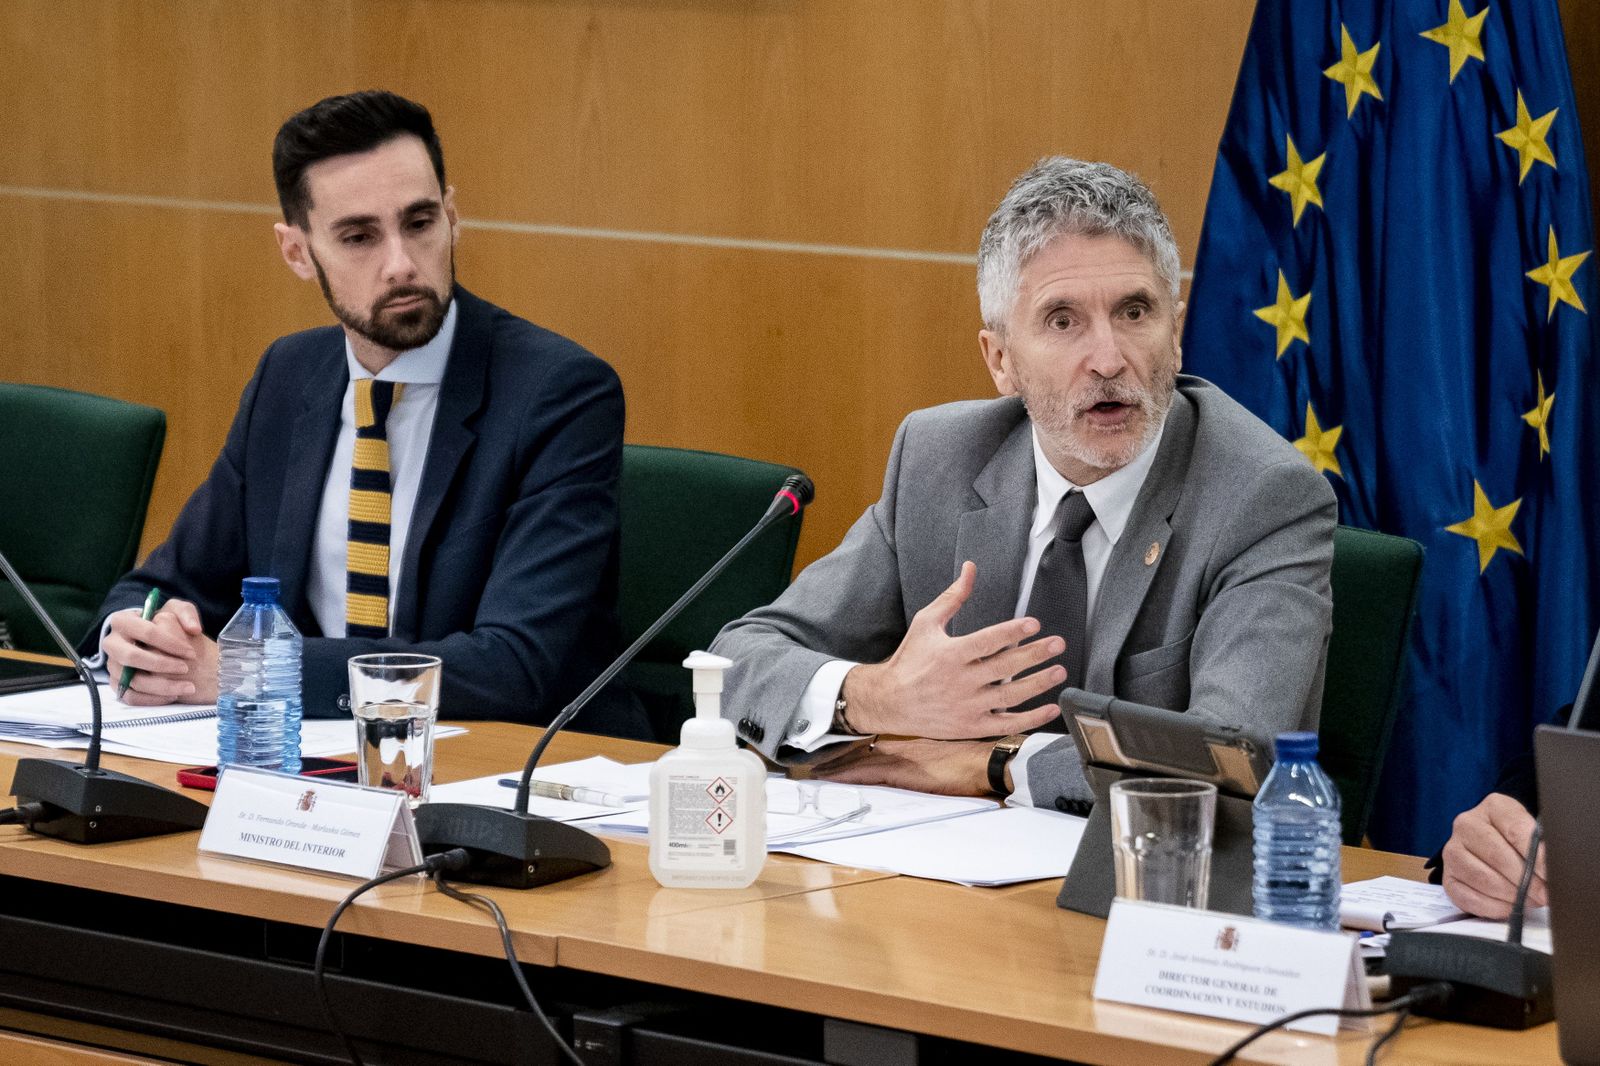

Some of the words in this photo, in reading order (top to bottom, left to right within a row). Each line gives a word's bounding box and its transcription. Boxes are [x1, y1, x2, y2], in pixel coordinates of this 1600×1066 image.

[239, 832, 283, 847] MINISTRO
[283, 840, 300, 851] DEL
[303, 842, 346, 858] INTERIOR
[1158, 970, 1210, 986] DIRECTOR
[1212, 980, 1260, 994] GENERAL
[1263, 984, 1279, 997] DE
[1225, 997, 1233, 1006] Y
[1235, 998, 1288, 1014] ESTUDIOS
